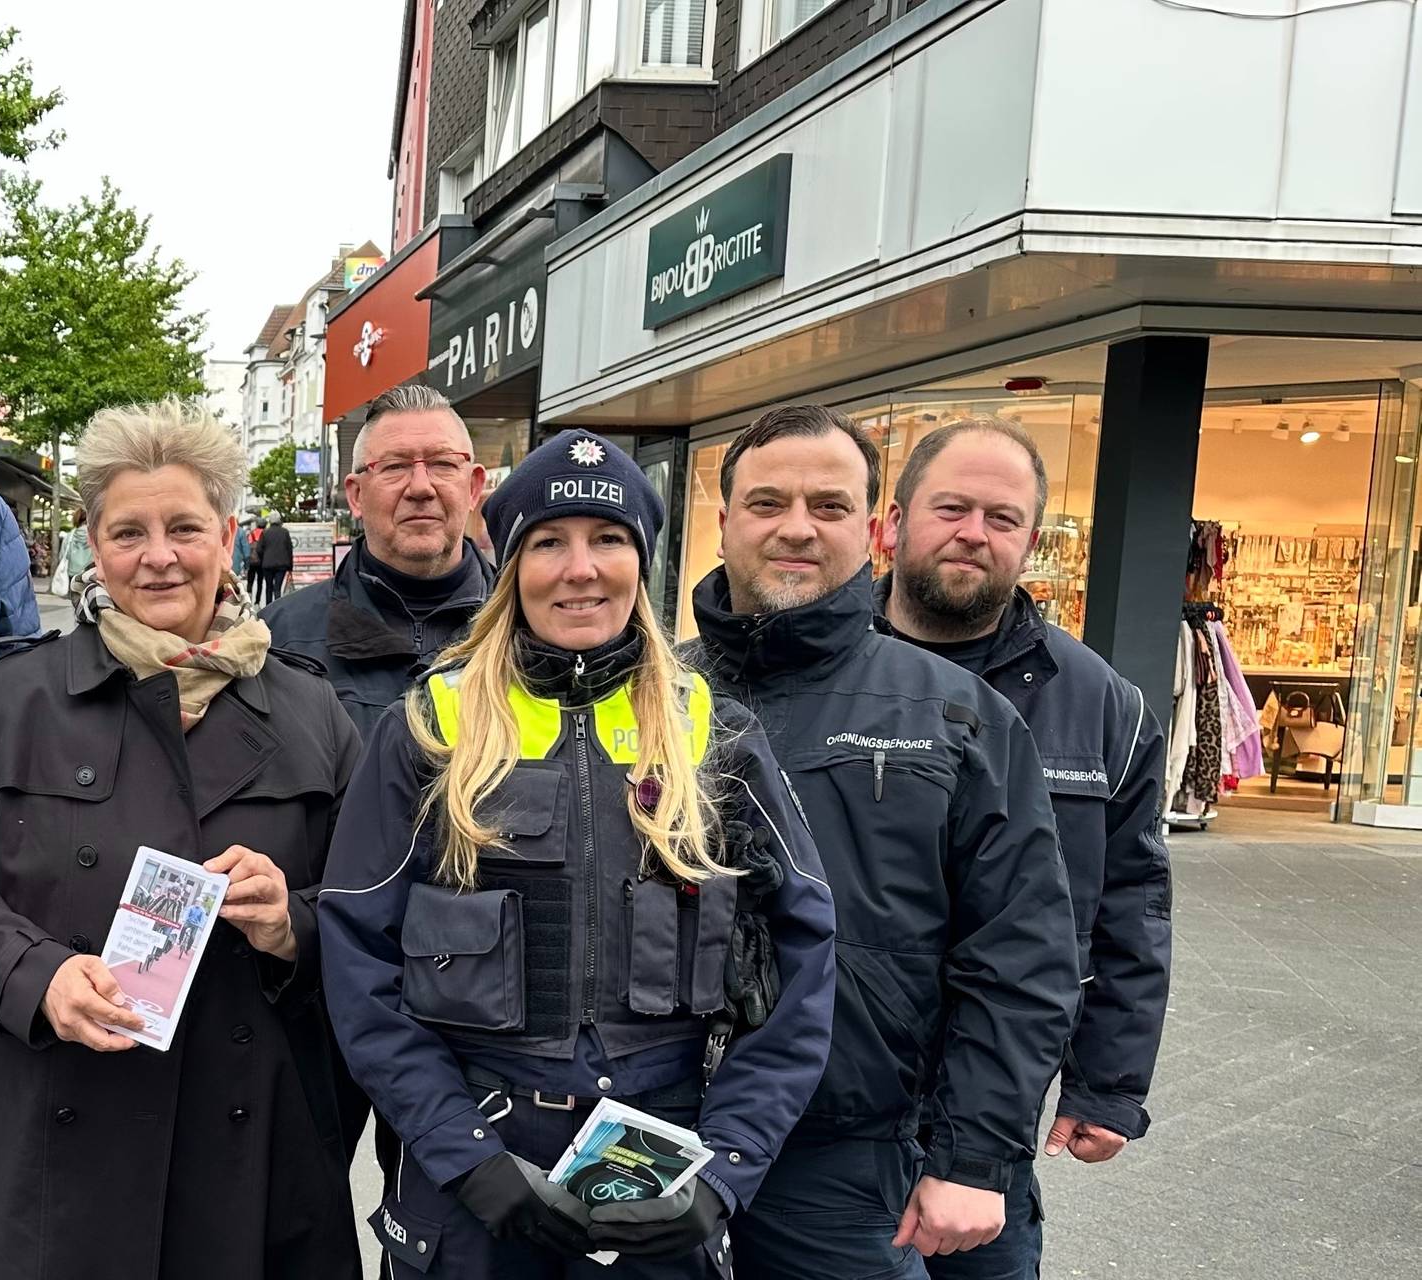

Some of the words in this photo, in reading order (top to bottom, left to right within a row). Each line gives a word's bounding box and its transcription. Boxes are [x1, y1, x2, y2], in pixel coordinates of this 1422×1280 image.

[650, 261, 685, 305] BIJOU
[550, 479, 624, 505] POLIZEI
[826, 731, 934, 750] ORDNUNGSBEHÖRDE
[1042, 767, 1109, 784] DNUNGSBEHÖRDE
